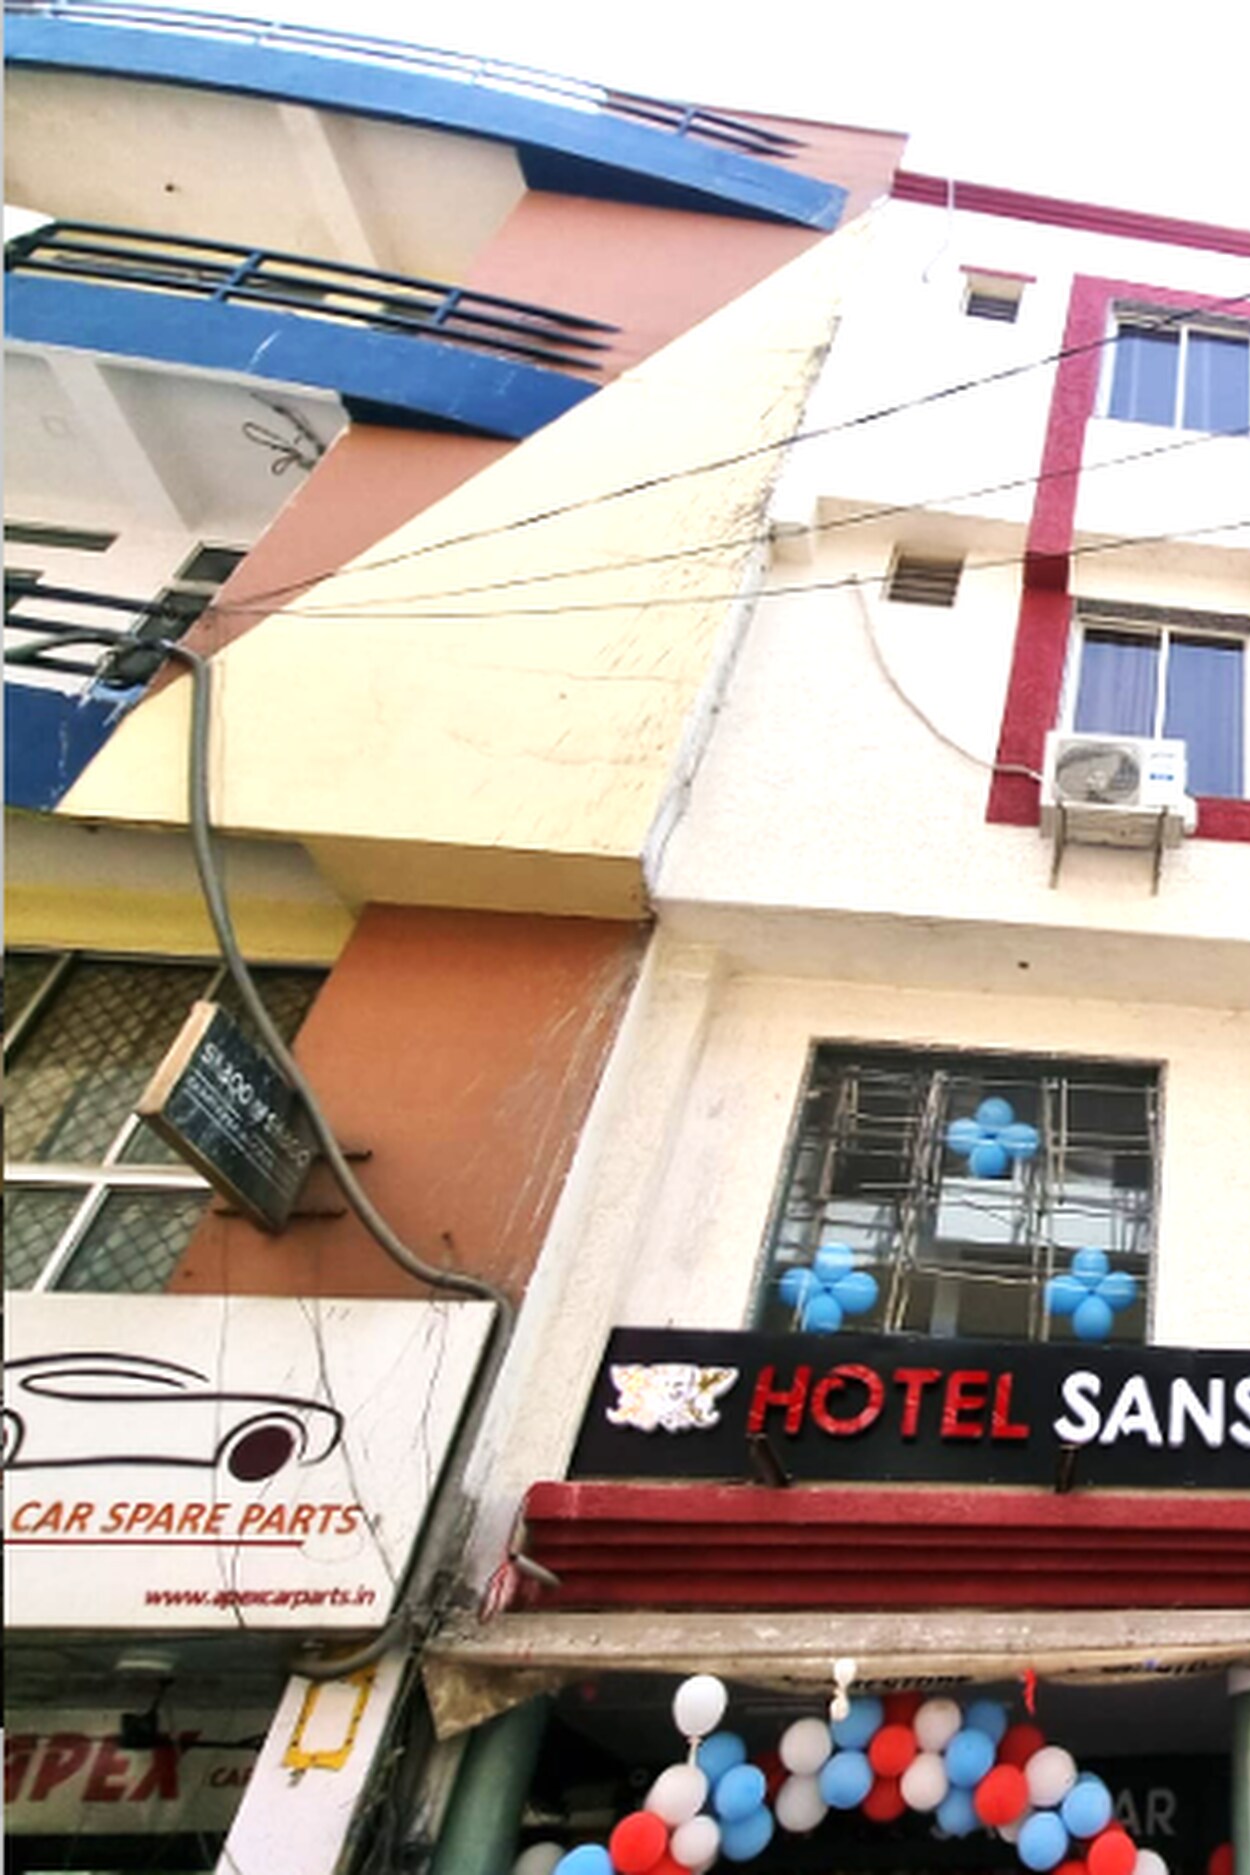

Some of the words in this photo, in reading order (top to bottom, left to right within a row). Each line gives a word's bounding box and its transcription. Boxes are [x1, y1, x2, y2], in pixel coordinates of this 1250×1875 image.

[747, 1364, 1031, 1440] HOTEL
[10, 1501, 95, 1533] CAR
[100, 1501, 231, 1535] SPARE
[238, 1502, 363, 1536] PARTS
